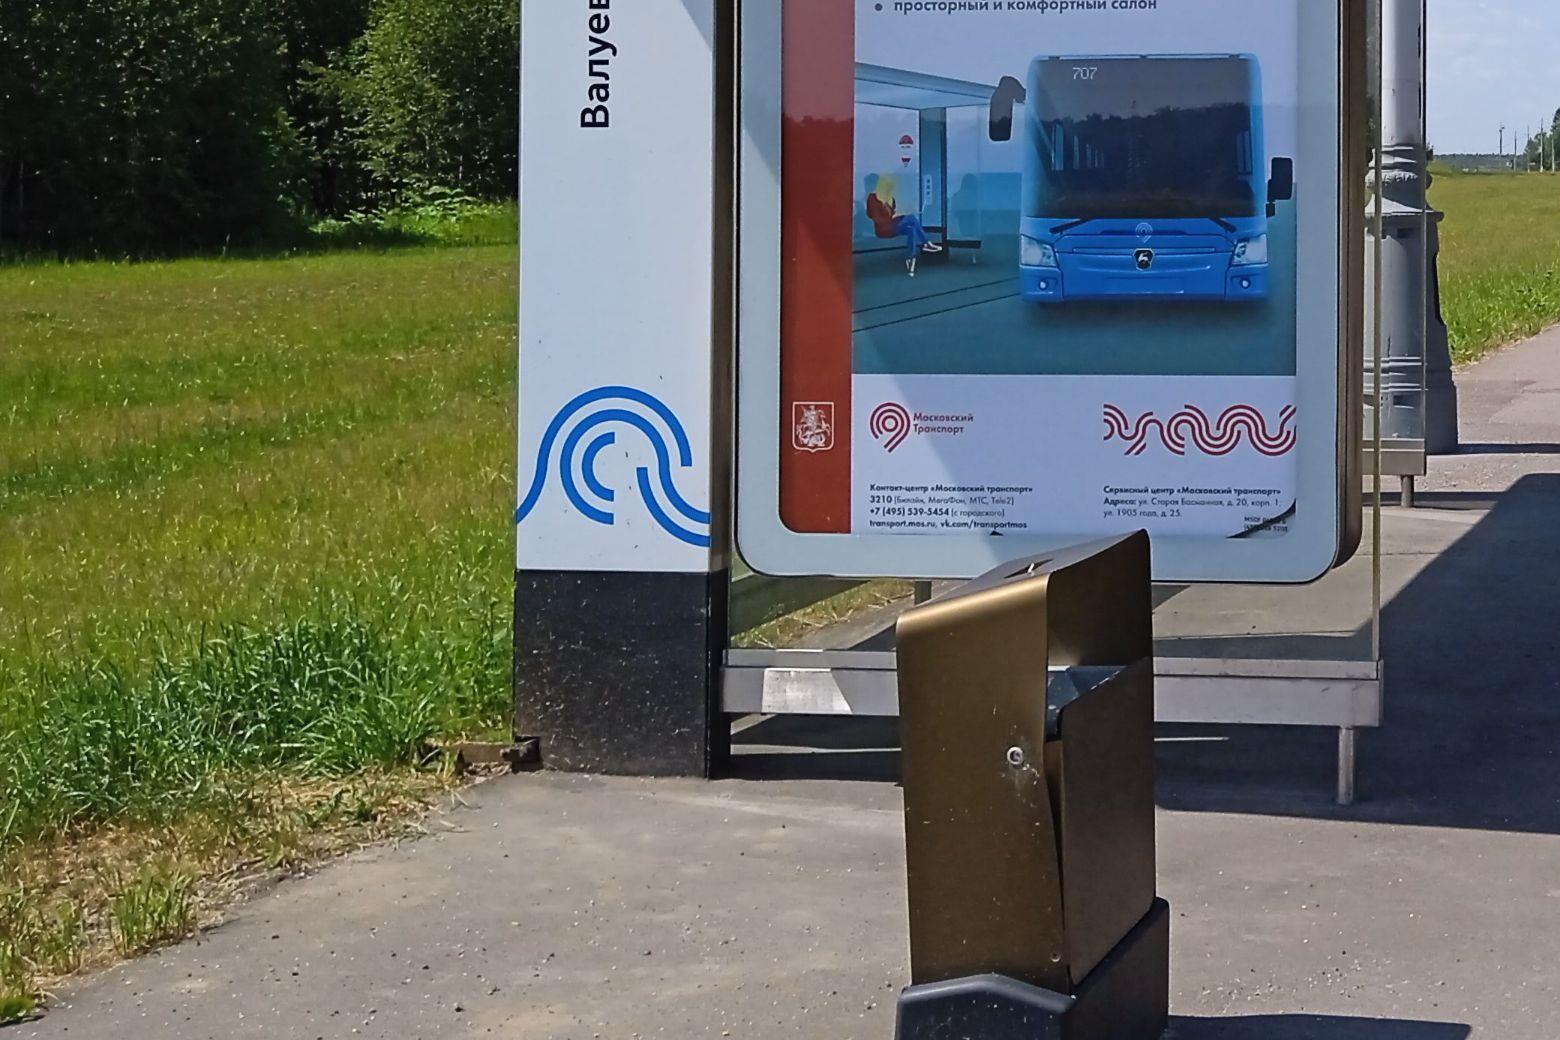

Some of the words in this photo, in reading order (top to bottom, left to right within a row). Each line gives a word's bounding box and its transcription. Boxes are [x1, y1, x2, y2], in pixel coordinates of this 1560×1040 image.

[993, 0, 1003, 11] и
[1111, 0, 1157, 10] салон
[1072, 67, 1098, 80] 707
[913, 413, 974, 422] Московский
[913, 424, 964, 435] Транспорт
[870, 484, 928, 493] Контакт-центр
[1151, 487, 1175, 495] центр
[870, 495, 893, 503] 3210
[870, 507, 880, 515] +7
[882, 506, 905, 516] (495)
[907, 507, 949, 516] 539-5454
